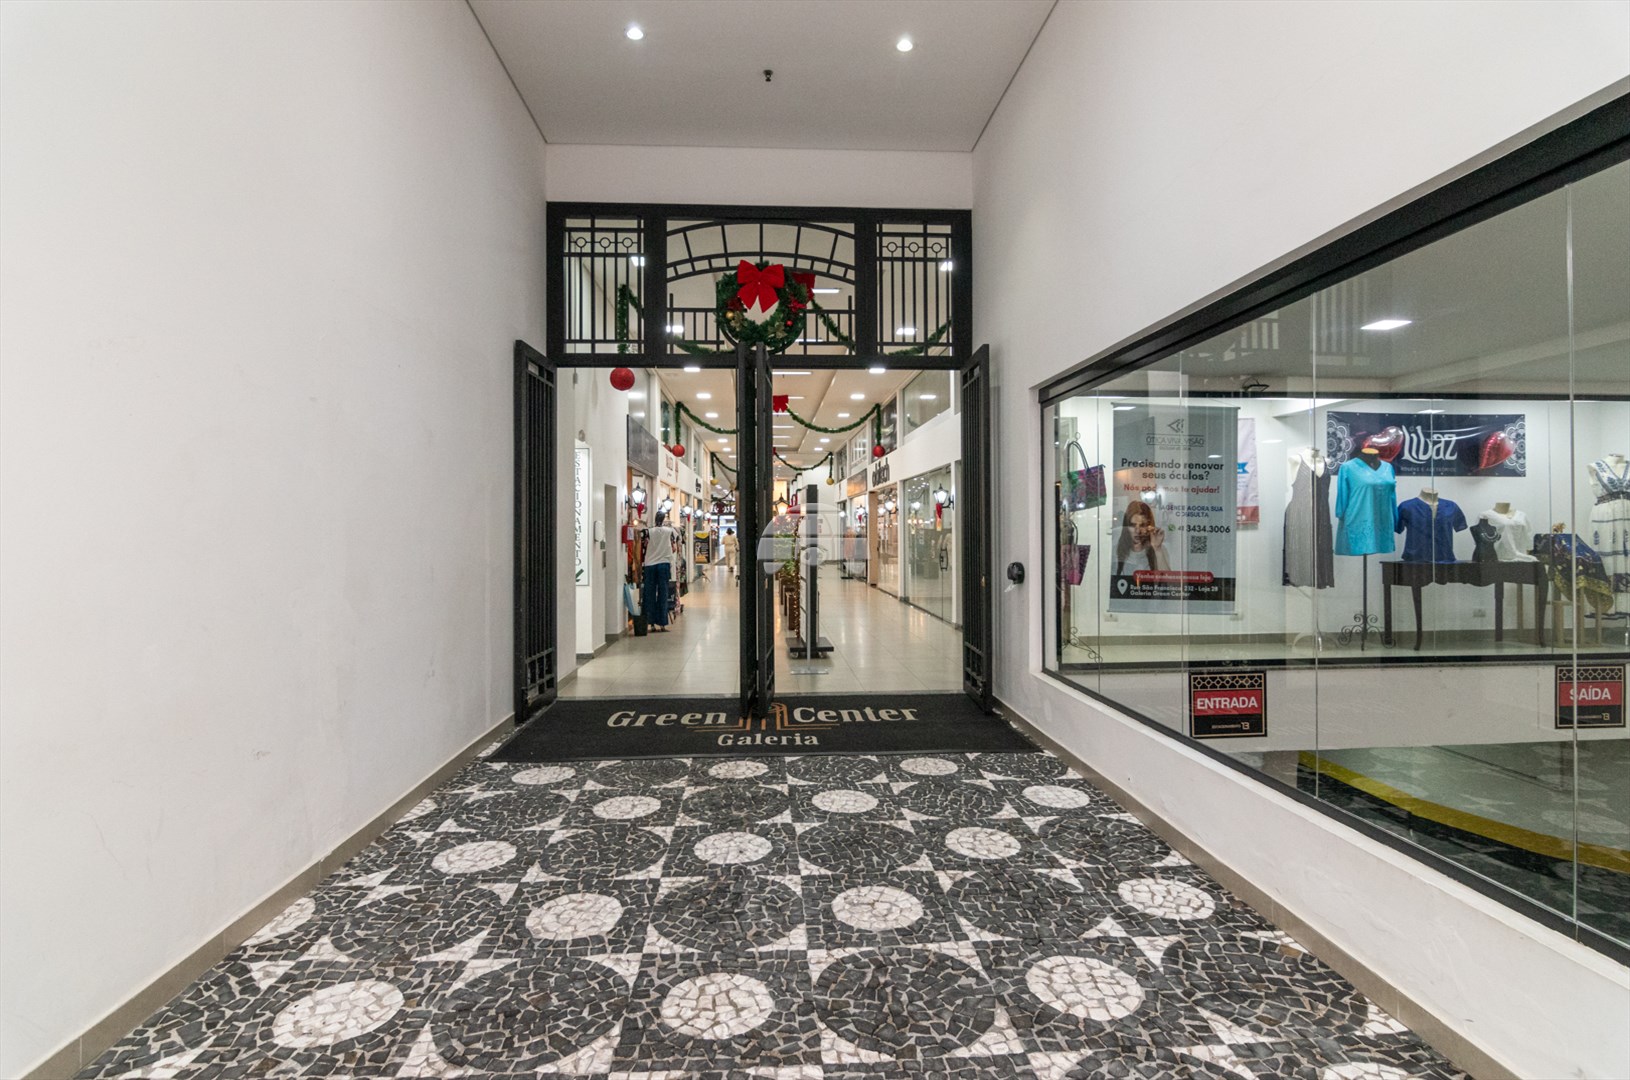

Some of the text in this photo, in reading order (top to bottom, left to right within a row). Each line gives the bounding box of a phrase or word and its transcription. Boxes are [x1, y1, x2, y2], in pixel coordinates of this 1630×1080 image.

[1121, 458, 1224, 470] Precisando renovar
[1142, 470, 1210, 480] seus óculos?
[1123, 483, 1139, 491] Nós
[1190, 485, 1220, 494] ajudar!
[1186, 524, 1231, 533] 3434.3006
[1569, 685, 1612, 701] SAÍDA
[1196, 696, 1258, 710] ENTRADA
[606, 705, 919, 727] Green Center
[717, 732, 820, 746] Galeria
